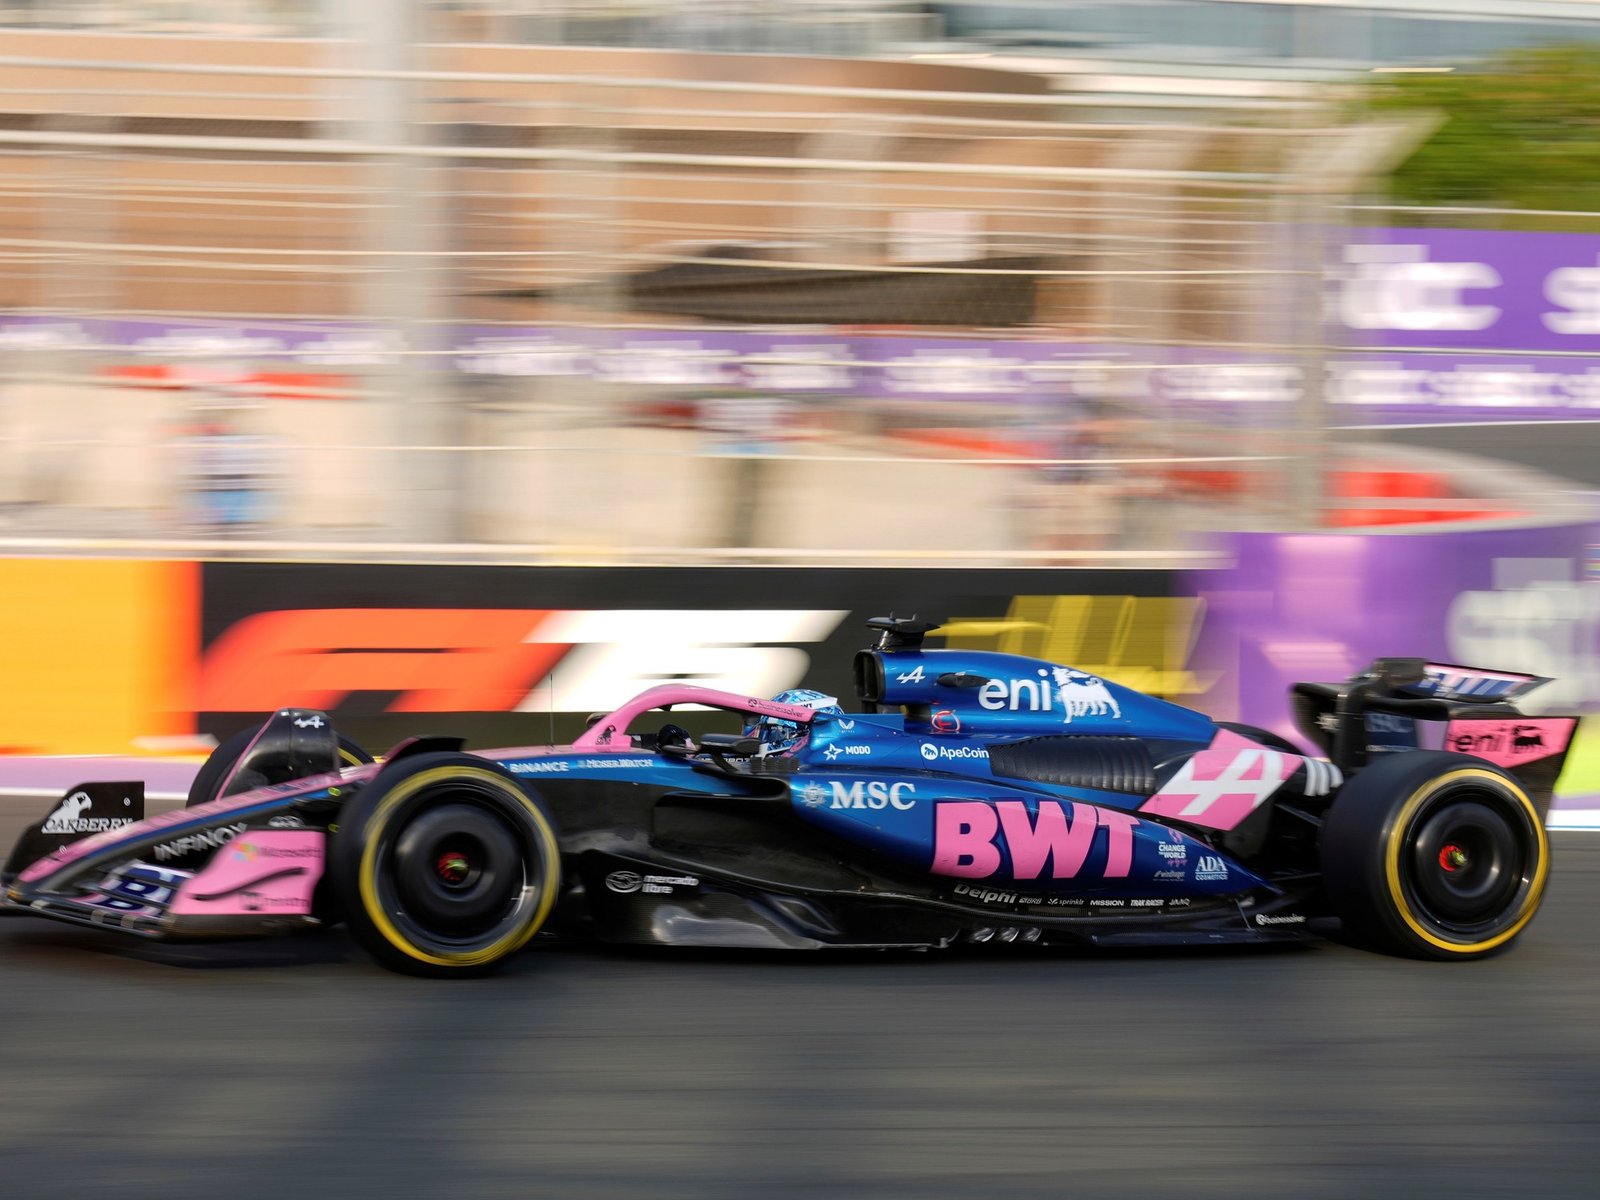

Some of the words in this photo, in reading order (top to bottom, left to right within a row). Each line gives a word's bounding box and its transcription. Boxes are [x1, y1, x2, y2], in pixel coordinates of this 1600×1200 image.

[978, 668, 1051, 711] eni
[845, 745, 871, 755] MODO
[939, 747, 990, 761] ApeCoin
[510, 761, 569, 773] BINANCE
[829, 781, 916, 810] MSC
[931, 801, 1140, 880] BWT
[1158, 844, 1187, 852] CHANGE
[1164, 851, 1187, 859] WORLD
[1195, 856, 1228, 872] ADA
[953, 884, 1019, 904] Delphi
[1090, 899, 1125, 907] MISSION
